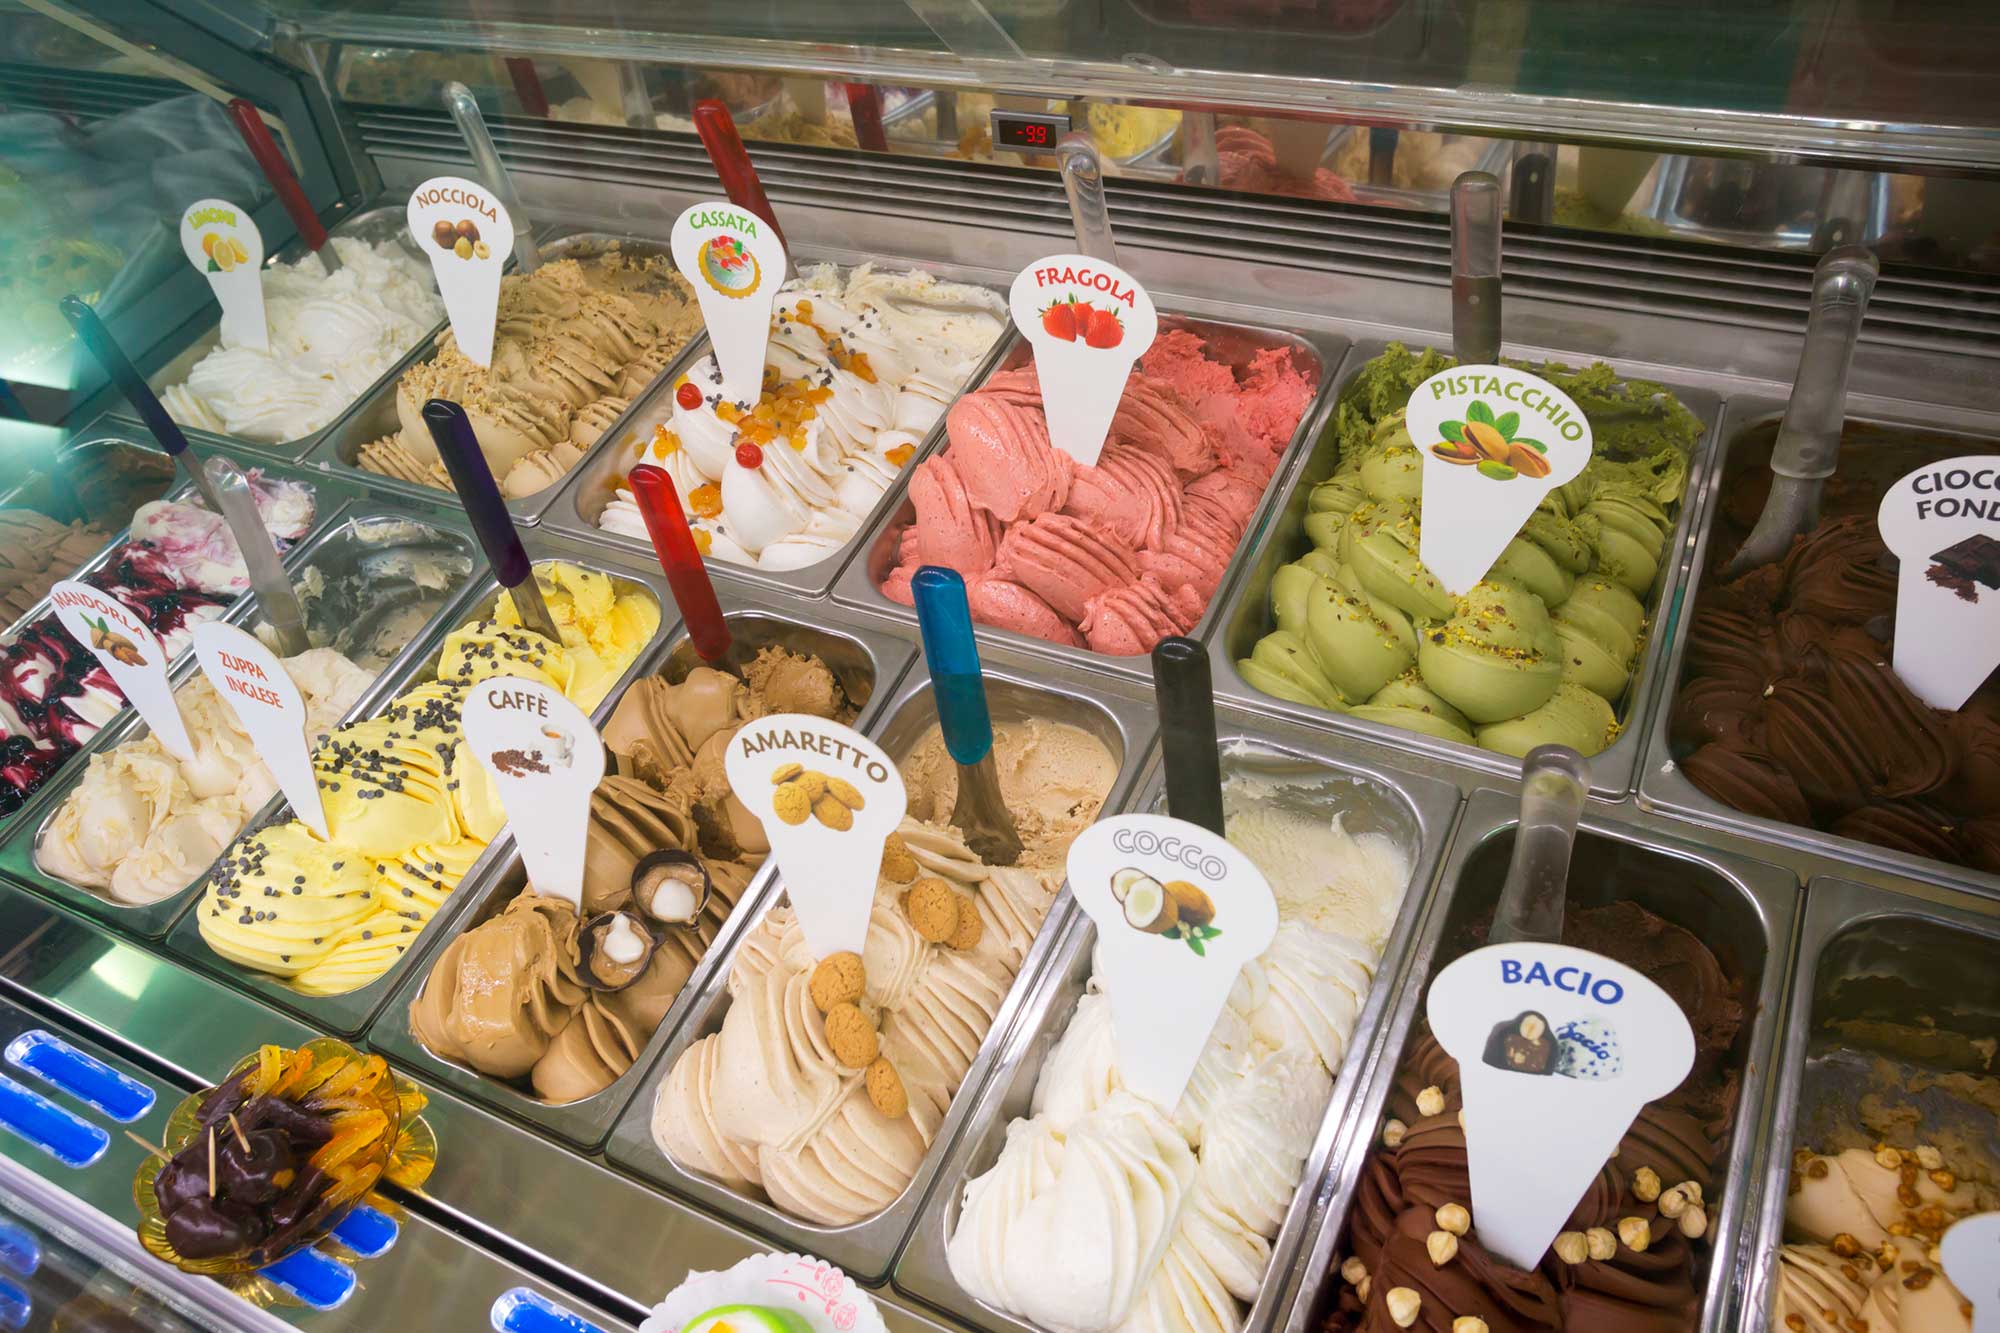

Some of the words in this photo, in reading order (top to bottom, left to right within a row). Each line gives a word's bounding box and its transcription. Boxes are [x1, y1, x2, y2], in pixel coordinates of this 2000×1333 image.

[416, 188, 496, 223] NOCCIOLA
[689, 211, 757, 239] CASSATA
[1034, 266, 1135, 308] FRAGOLA
[1430, 375, 1583, 441] PISTACCHIO
[51, 591, 145, 641] MANDORLA
[218, 650, 269, 682] ZUPPA
[224, 674, 284, 709] INGLESE
[487, 689, 548, 718] CAFFÈ
[741, 729, 888, 783] AMARETTO
[1113, 828, 1227, 881] COCCO
[1500, 959, 1624, 1005] BACIO
